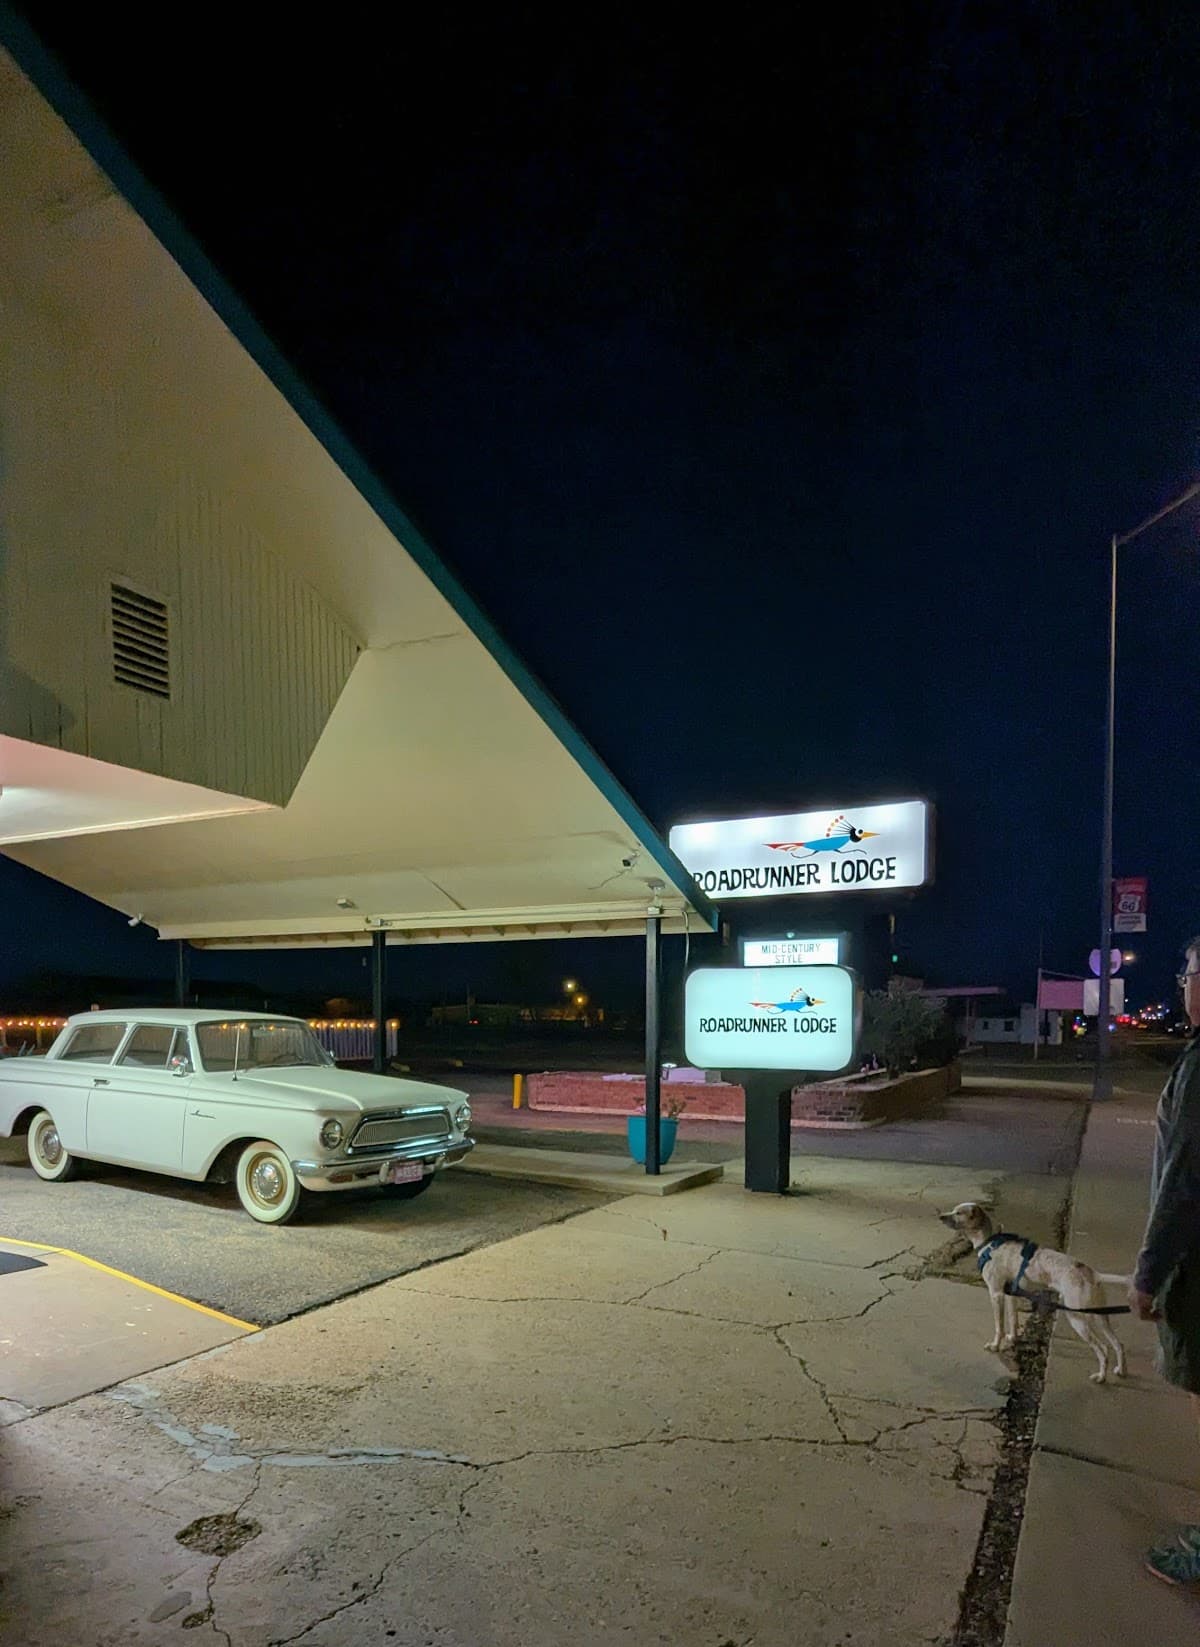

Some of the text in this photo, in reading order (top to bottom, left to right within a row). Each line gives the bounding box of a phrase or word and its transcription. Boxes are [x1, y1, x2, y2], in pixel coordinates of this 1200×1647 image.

[692, 857, 897, 893] ROADRUNNER LODGE
[1121, 901, 1136, 911] 66
[761, 943, 822, 954] MID-CENTURY
[775, 954, 803, 964] STYLE
[699, 1017, 837, 1034] ROADRUNNER LODGE
